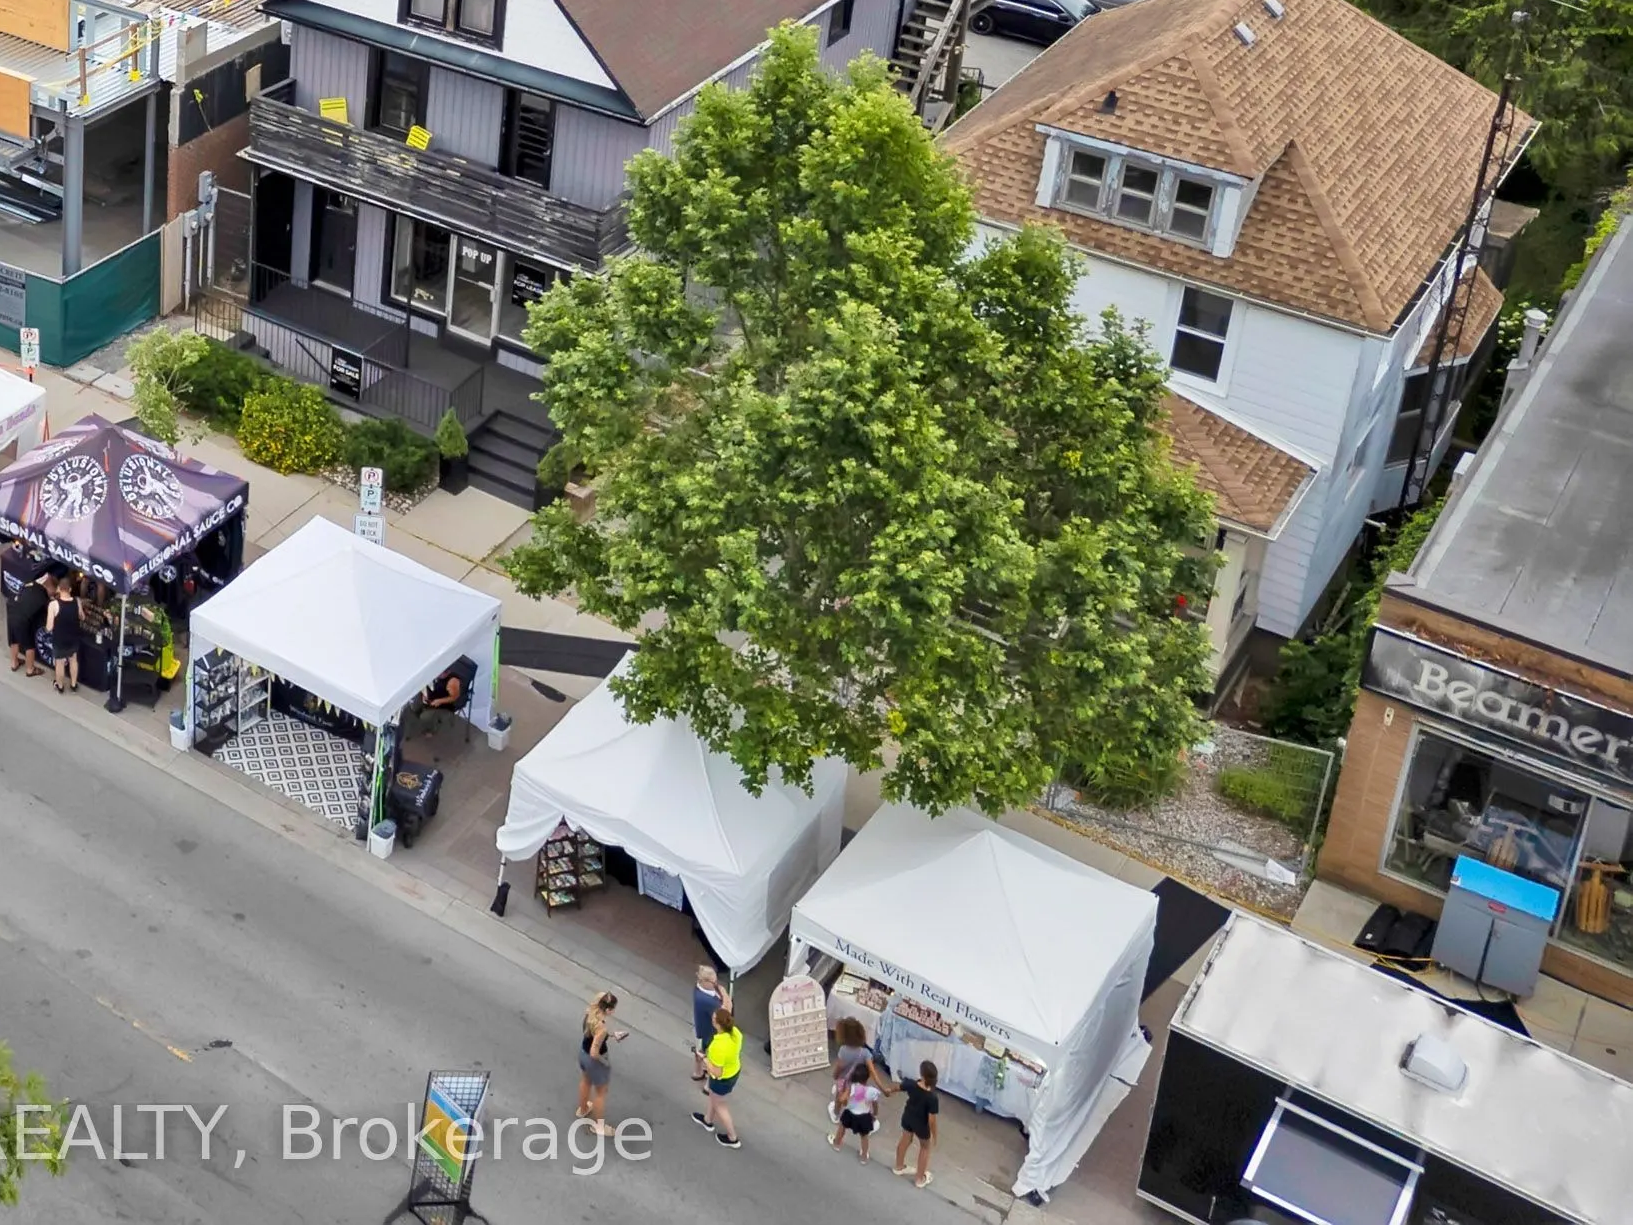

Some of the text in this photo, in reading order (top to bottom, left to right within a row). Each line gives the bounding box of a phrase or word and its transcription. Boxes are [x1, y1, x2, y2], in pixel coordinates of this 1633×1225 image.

[462, 246, 492, 265] POP UP
[333, 364, 345, 374] FOR
[48, 540, 90, 572] SAUCE
[131, 529, 193, 583] DELUSIONAL
[193, 507, 225, 539] SAUCE
[835, 939, 1012, 1041] Made With Real Flowers
